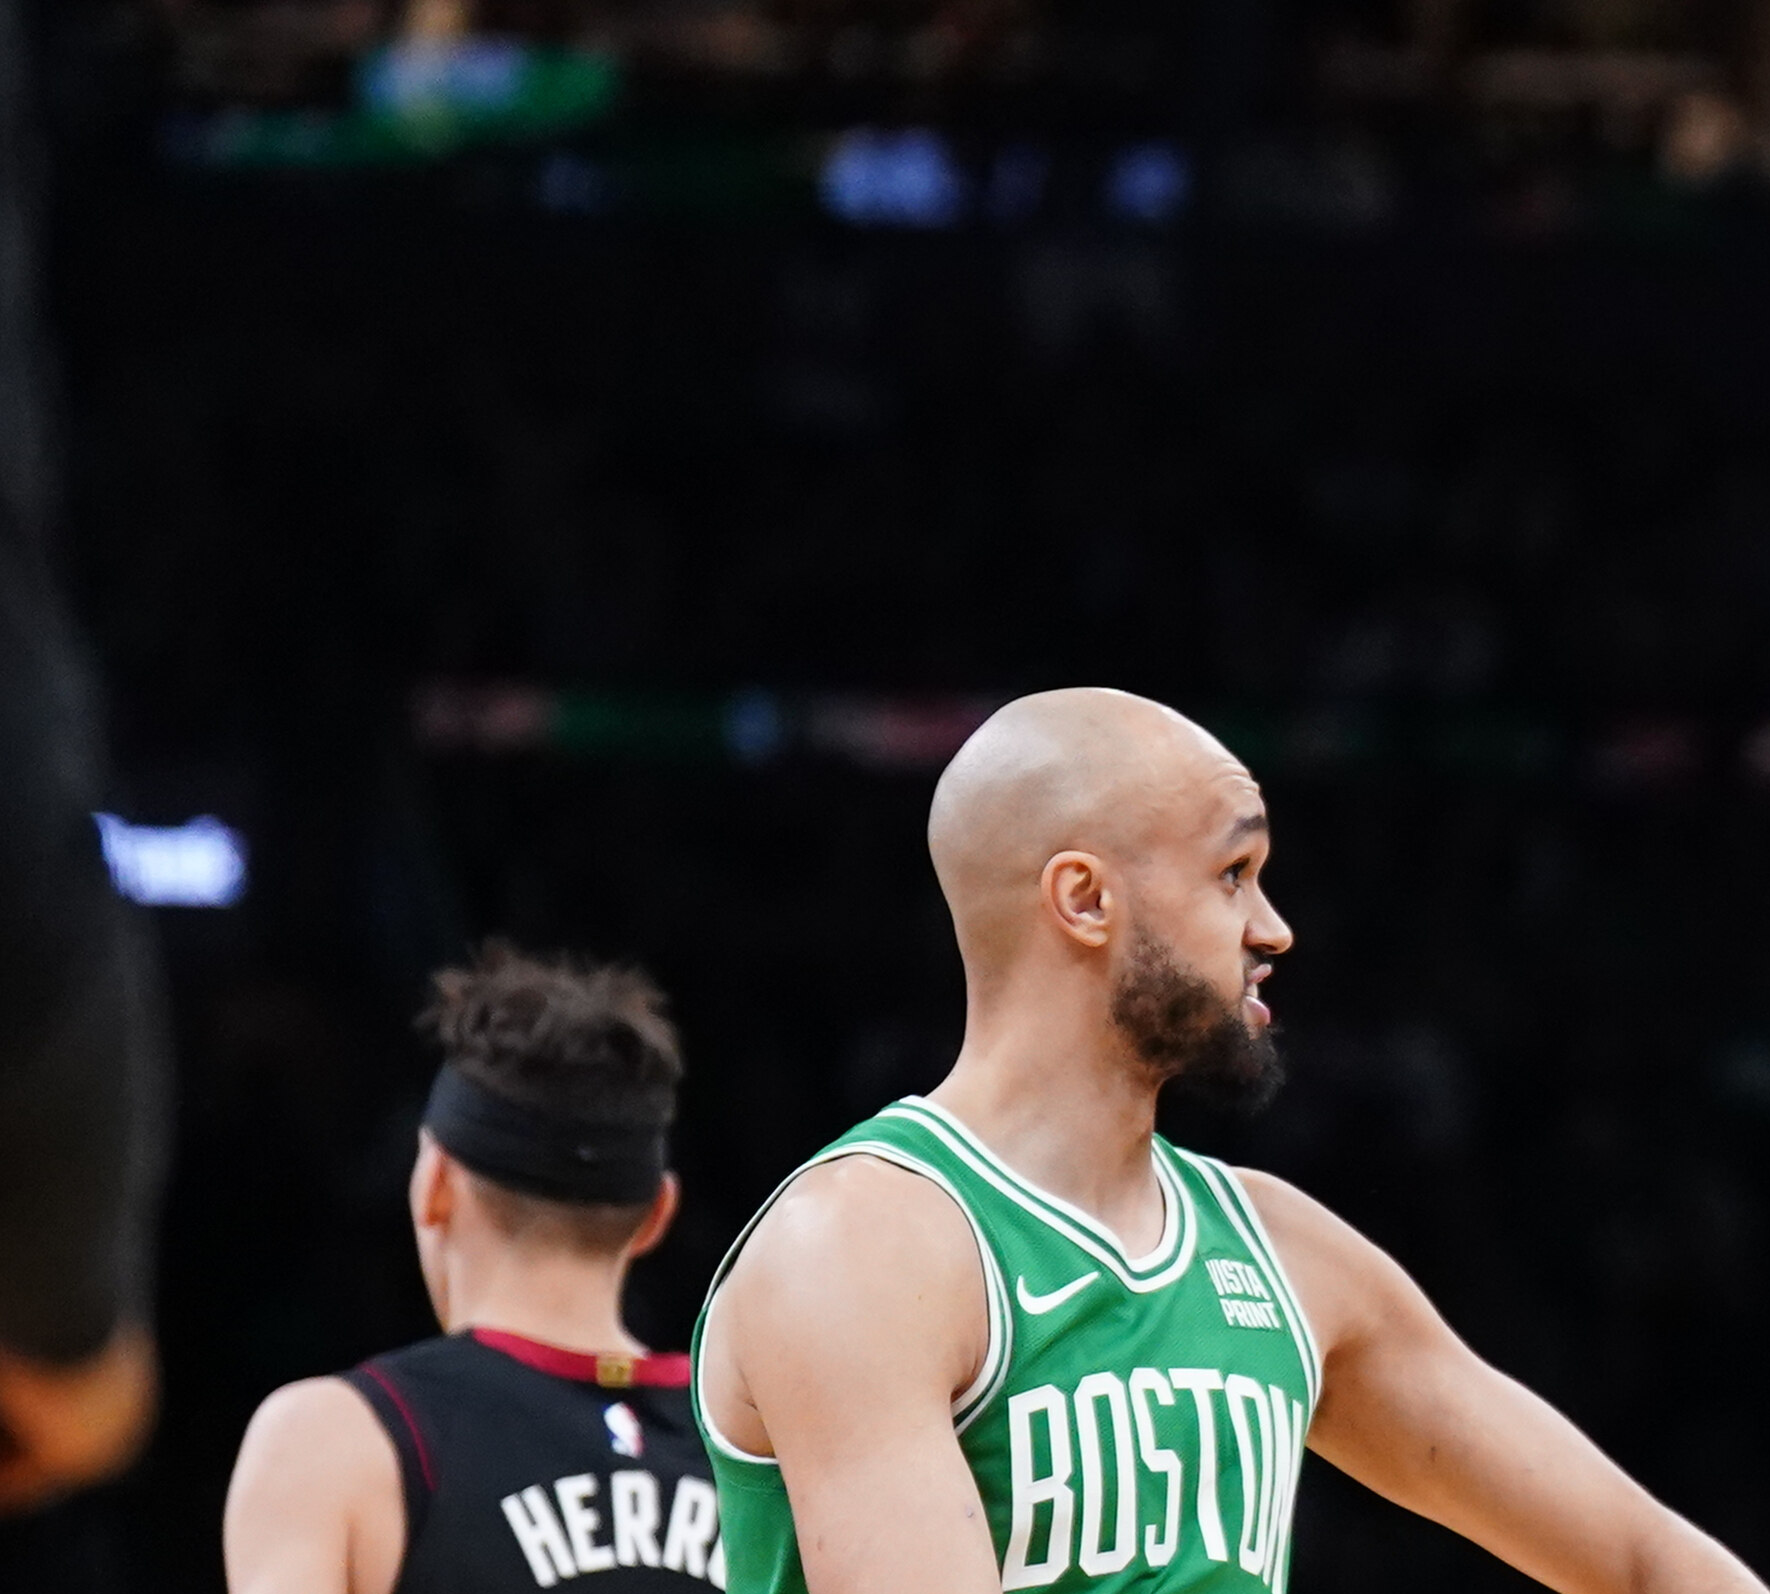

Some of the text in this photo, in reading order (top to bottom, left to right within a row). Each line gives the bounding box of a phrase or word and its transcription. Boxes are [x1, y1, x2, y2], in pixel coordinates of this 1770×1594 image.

[1204, 1258, 1273, 1302] VISTA
[1219, 1298, 1282, 1329] PRINT
[500, 1469, 728, 1589] HERR
